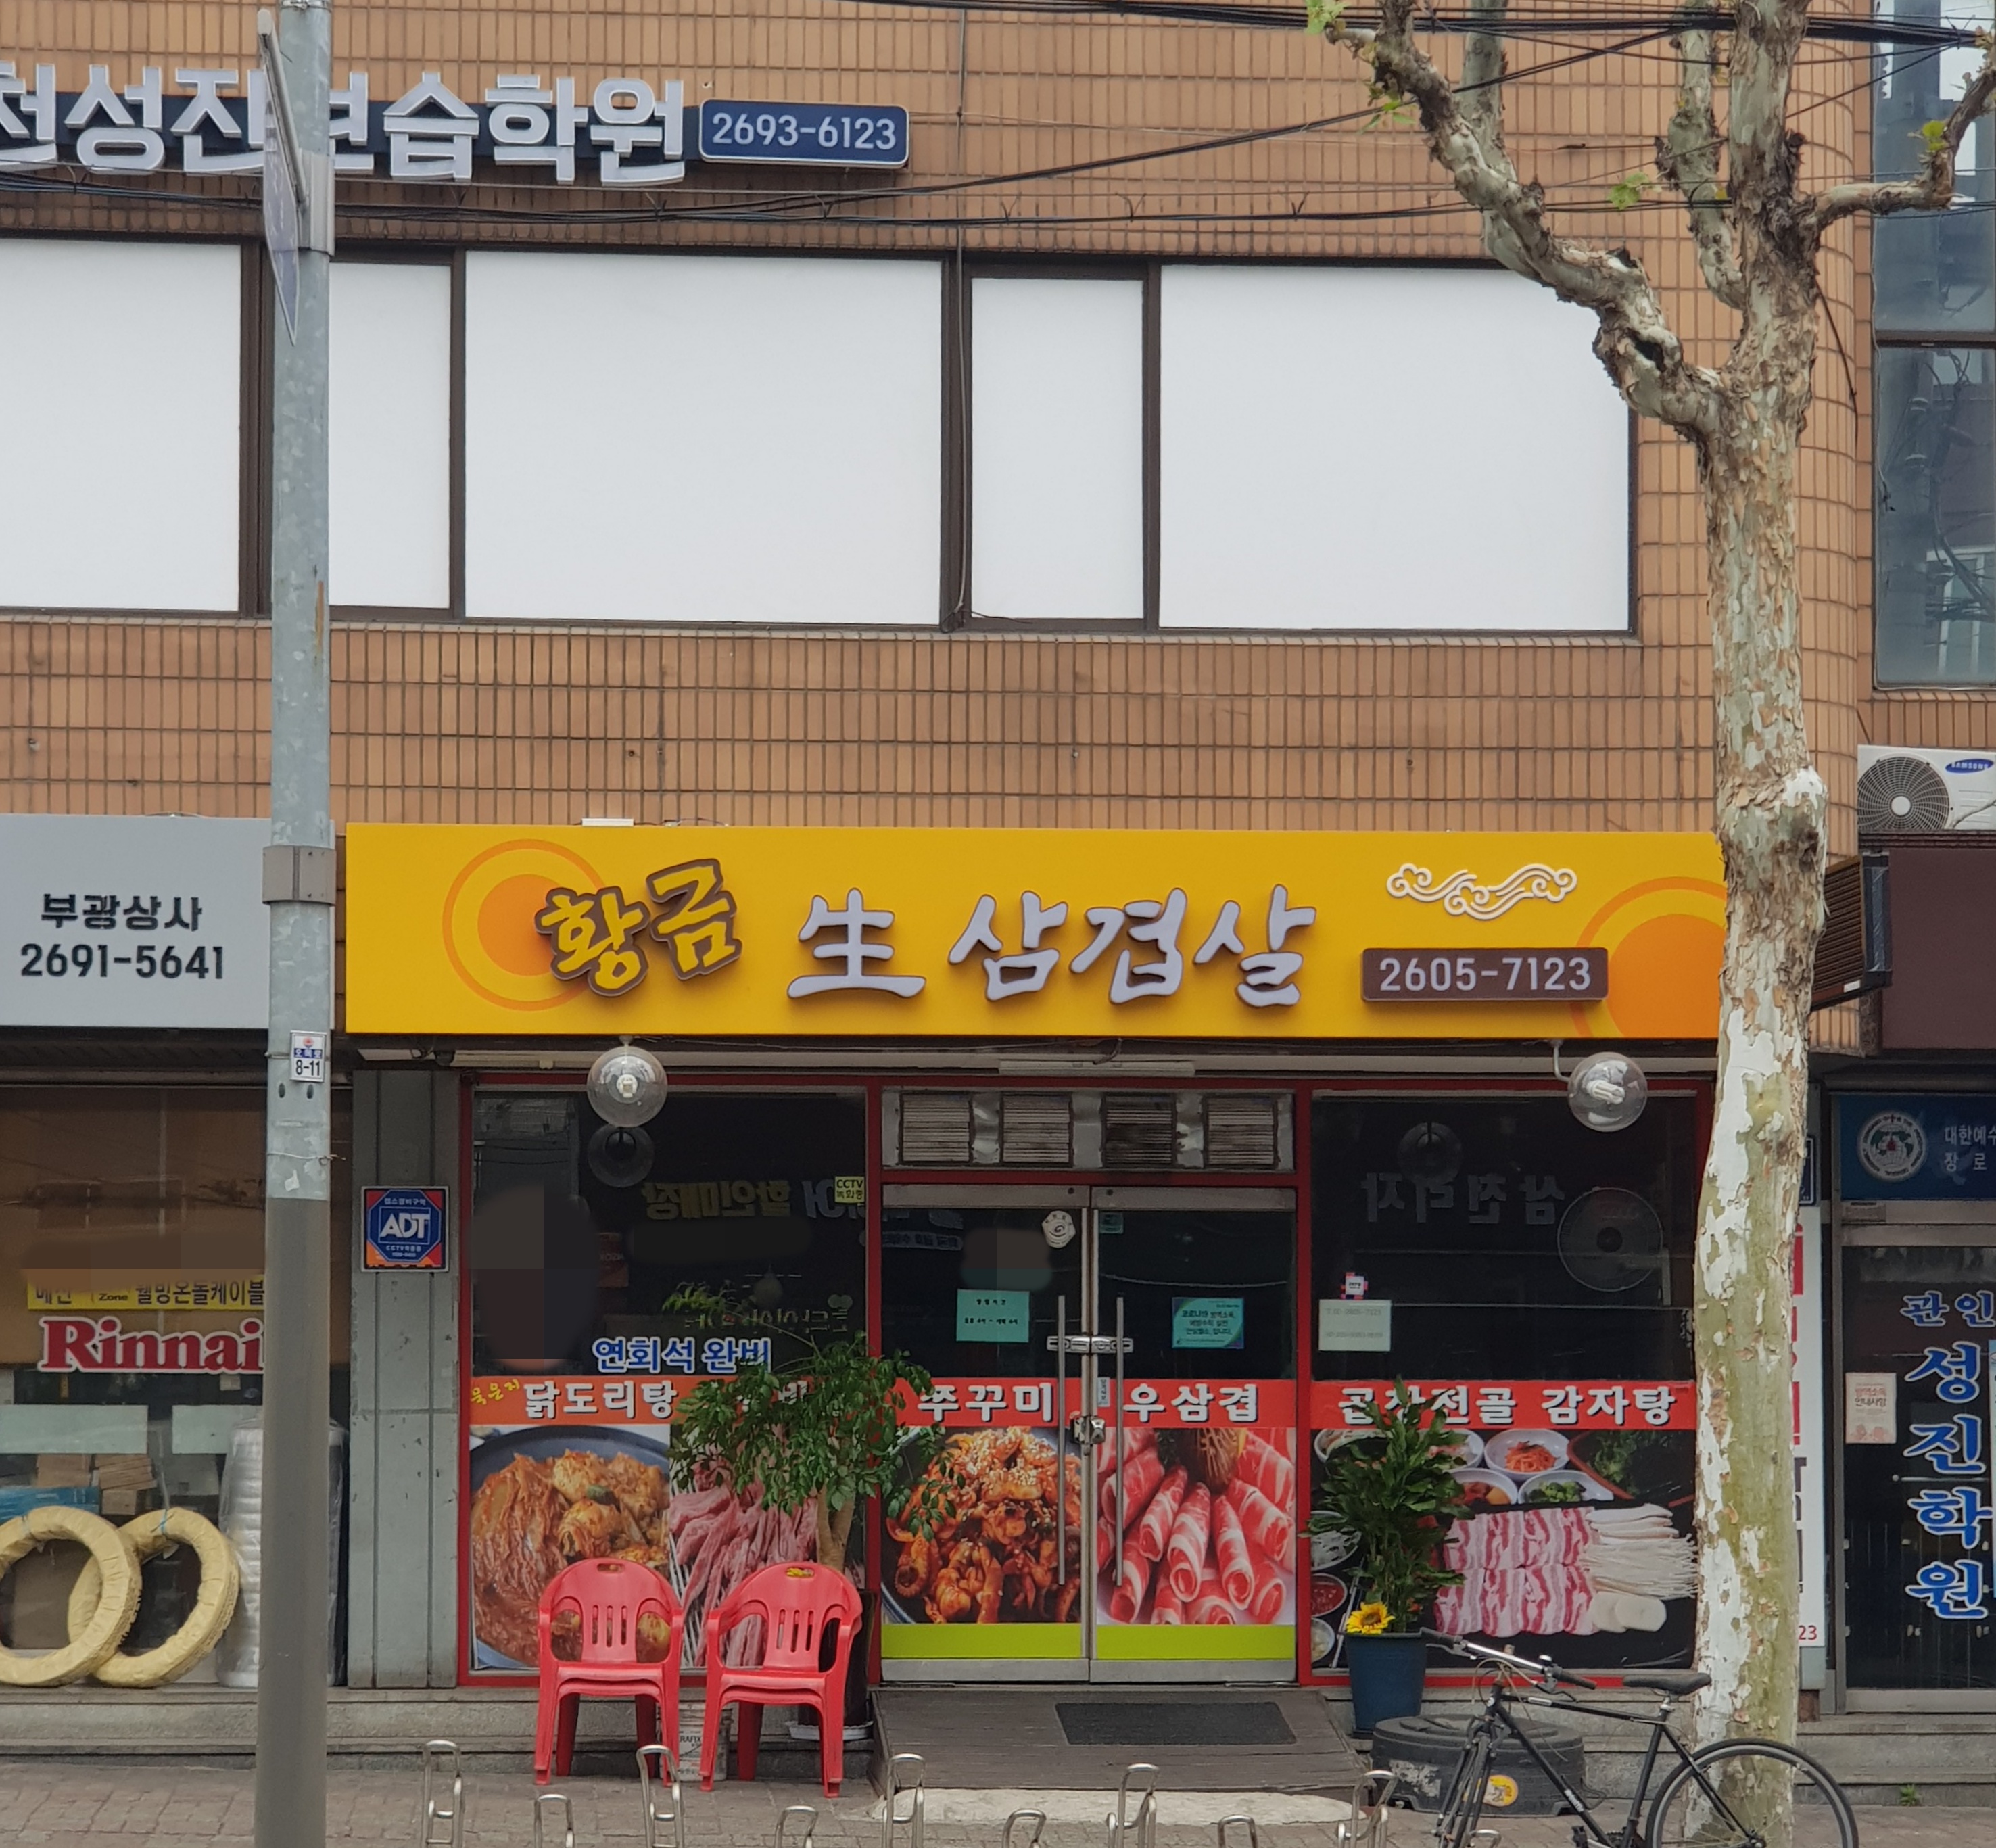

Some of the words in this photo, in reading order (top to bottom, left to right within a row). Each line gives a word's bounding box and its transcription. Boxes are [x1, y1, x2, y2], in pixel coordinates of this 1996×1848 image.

[712, 112, 897, 150] 2693-6123
[1951, 761, 1989, 770] SAMSUNG
[41, 893, 203, 932] 부광상사
[535, 858, 742, 997] 황금
[787, 888, 927, 999] 生
[948, 884, 1316, 1008] 삼겹살
[20, 943, 224, 980] 2691-5641
[1379, 957, 1592, 991] 2605-7123
[295, 1059, 320, 1076] 8-11
[836, 1179, 863, 1188] CCTV
[379, 1212, 431, 1239] ADT
[99, 1293, 128, 1301] Zone
[1900, 1290, 1996, 1327] 관인
[39, 1317, 264, 1374] Rinnai
[592, 1336, 695, 1374] 연회석
[701, 1336, 771, 1373] 완비
[471, 1378, 520, 1405] 묵은지
[523, 1379, 677, 1419] 닭도리탕
[1123, 1382, 1258, 1423] 우삼겹
[1541, 1385, 1676, 1425] 감자탕
[1903, 1342, 1993, 1620] 성진학원
